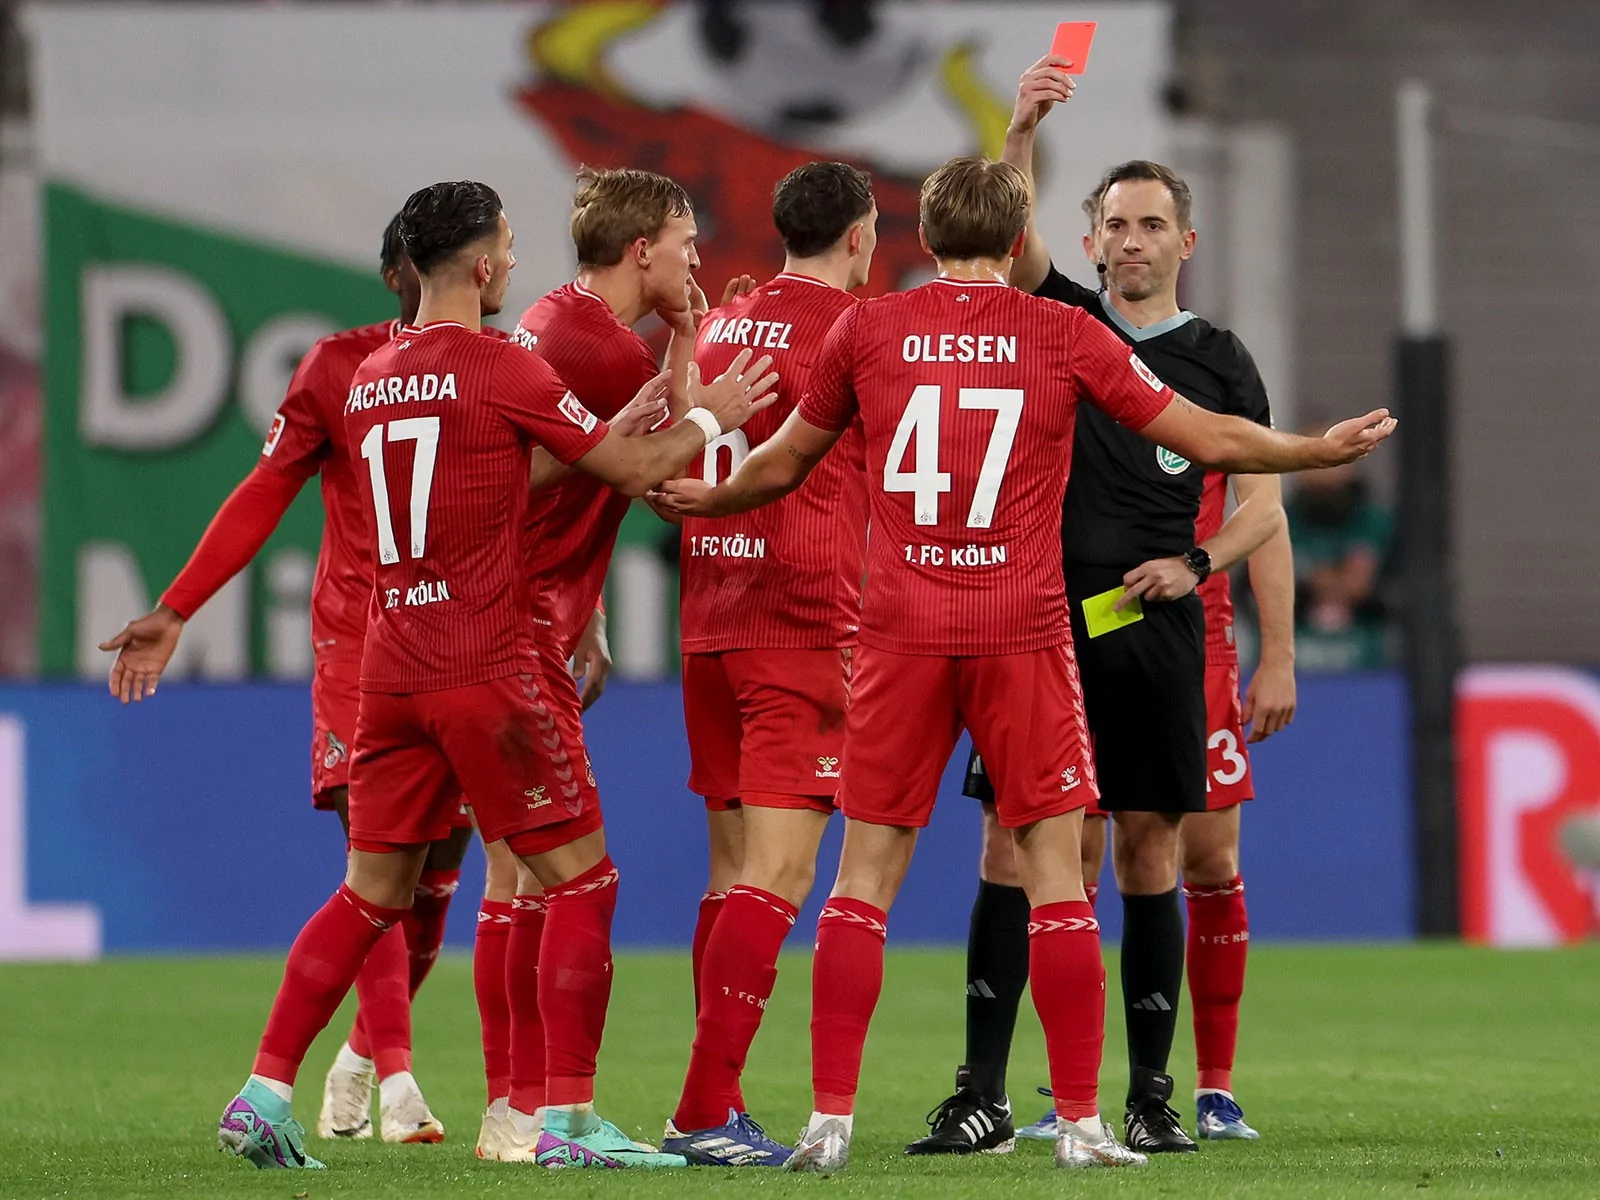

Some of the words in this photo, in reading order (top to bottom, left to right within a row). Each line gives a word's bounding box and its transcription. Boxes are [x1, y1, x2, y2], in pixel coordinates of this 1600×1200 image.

[703, 318, 792, 349] MARTEL
[902, 334, 1016, 363] OLESEN
[883, 385, 1024, 528] 47
[360, 416, 440, 565] 17
[722, 533, 765, 558] KÖLN
[951, 544, 1006, 566] KÖLN
[405, 580, 450, 606] KÖLN
[1205, 728, 1247, 792] 3
[738, 991, 756, 1004] FC
